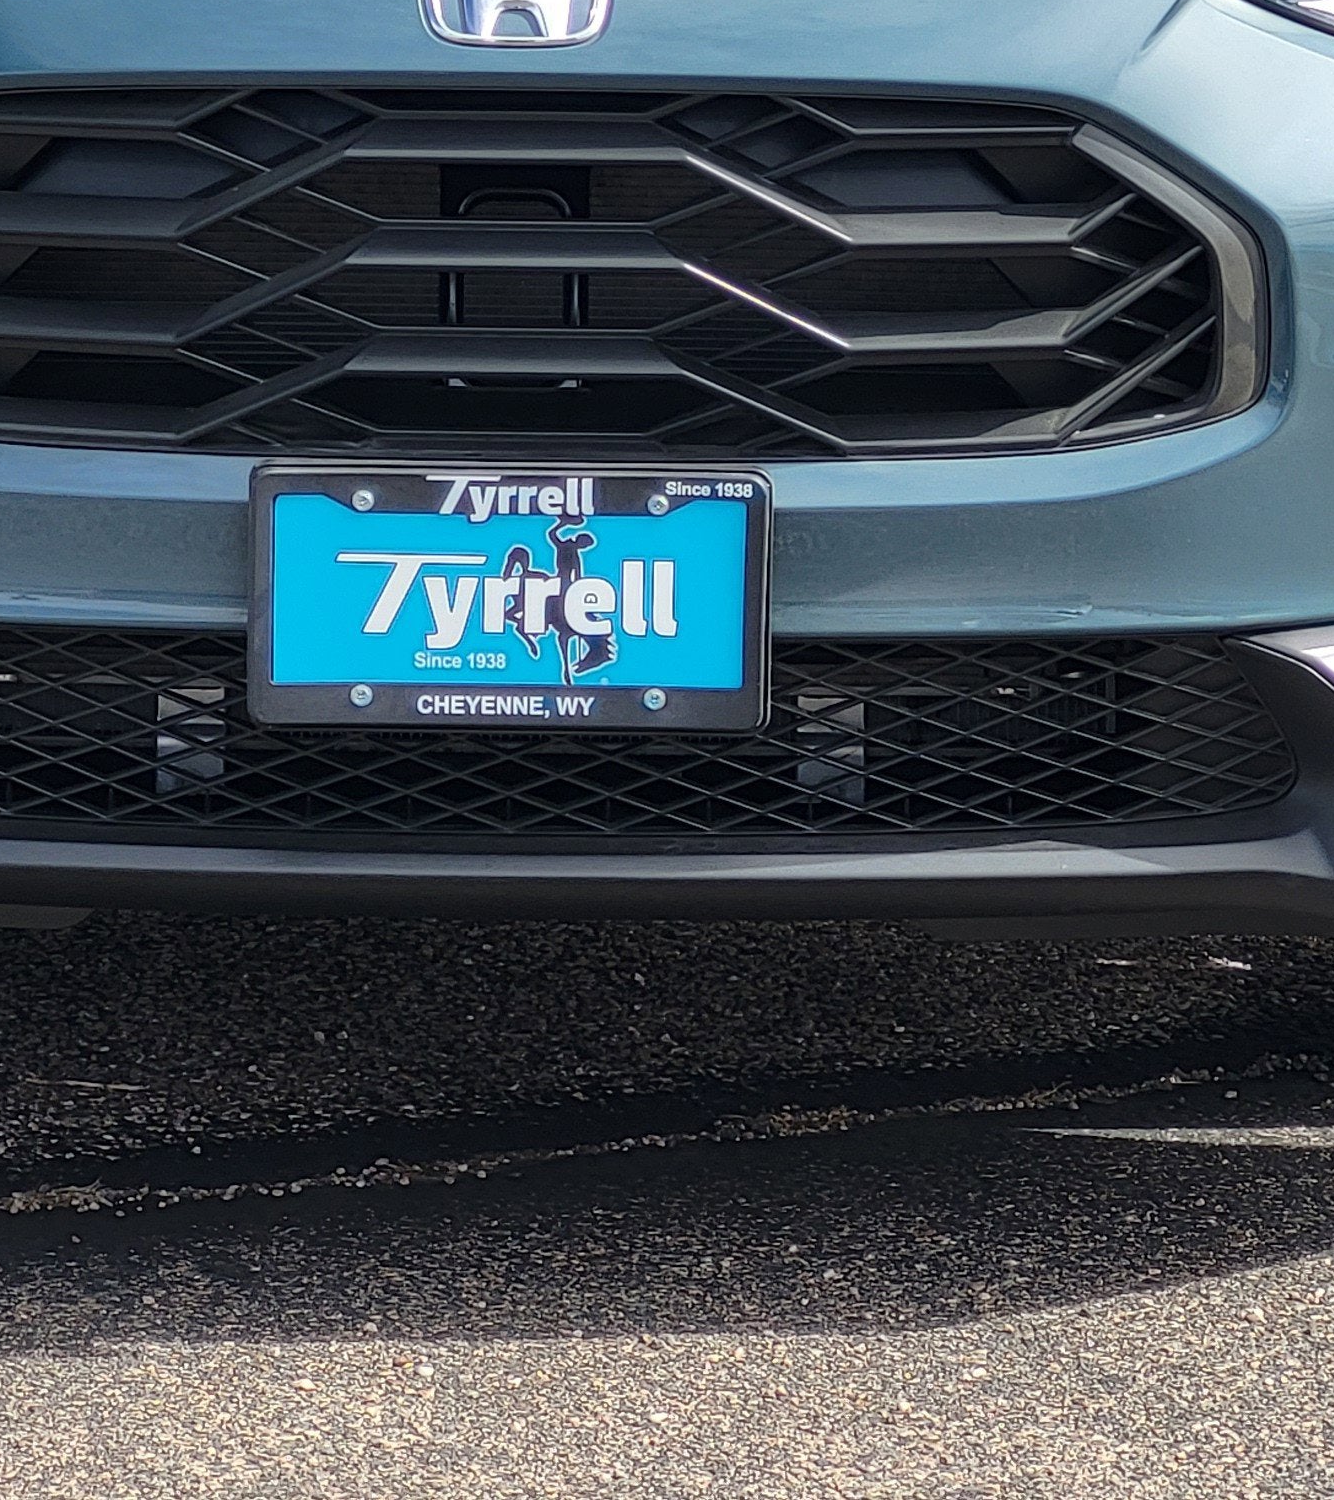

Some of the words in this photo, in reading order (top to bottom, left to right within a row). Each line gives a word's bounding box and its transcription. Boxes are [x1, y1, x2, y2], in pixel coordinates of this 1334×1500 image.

[425, 474, 595, 523] Tyrrell
[665, 481, 711, 497] Since
[714, 482, 754, 499] 1938
[335, 552, 678, 650] Tyrrell
[413, 652, 462, 669] Since
[466, 652, 507, 670] 1938
[417, 694, 550, 719] CHEYENNE,
[555, 696, 595, 717] WY
